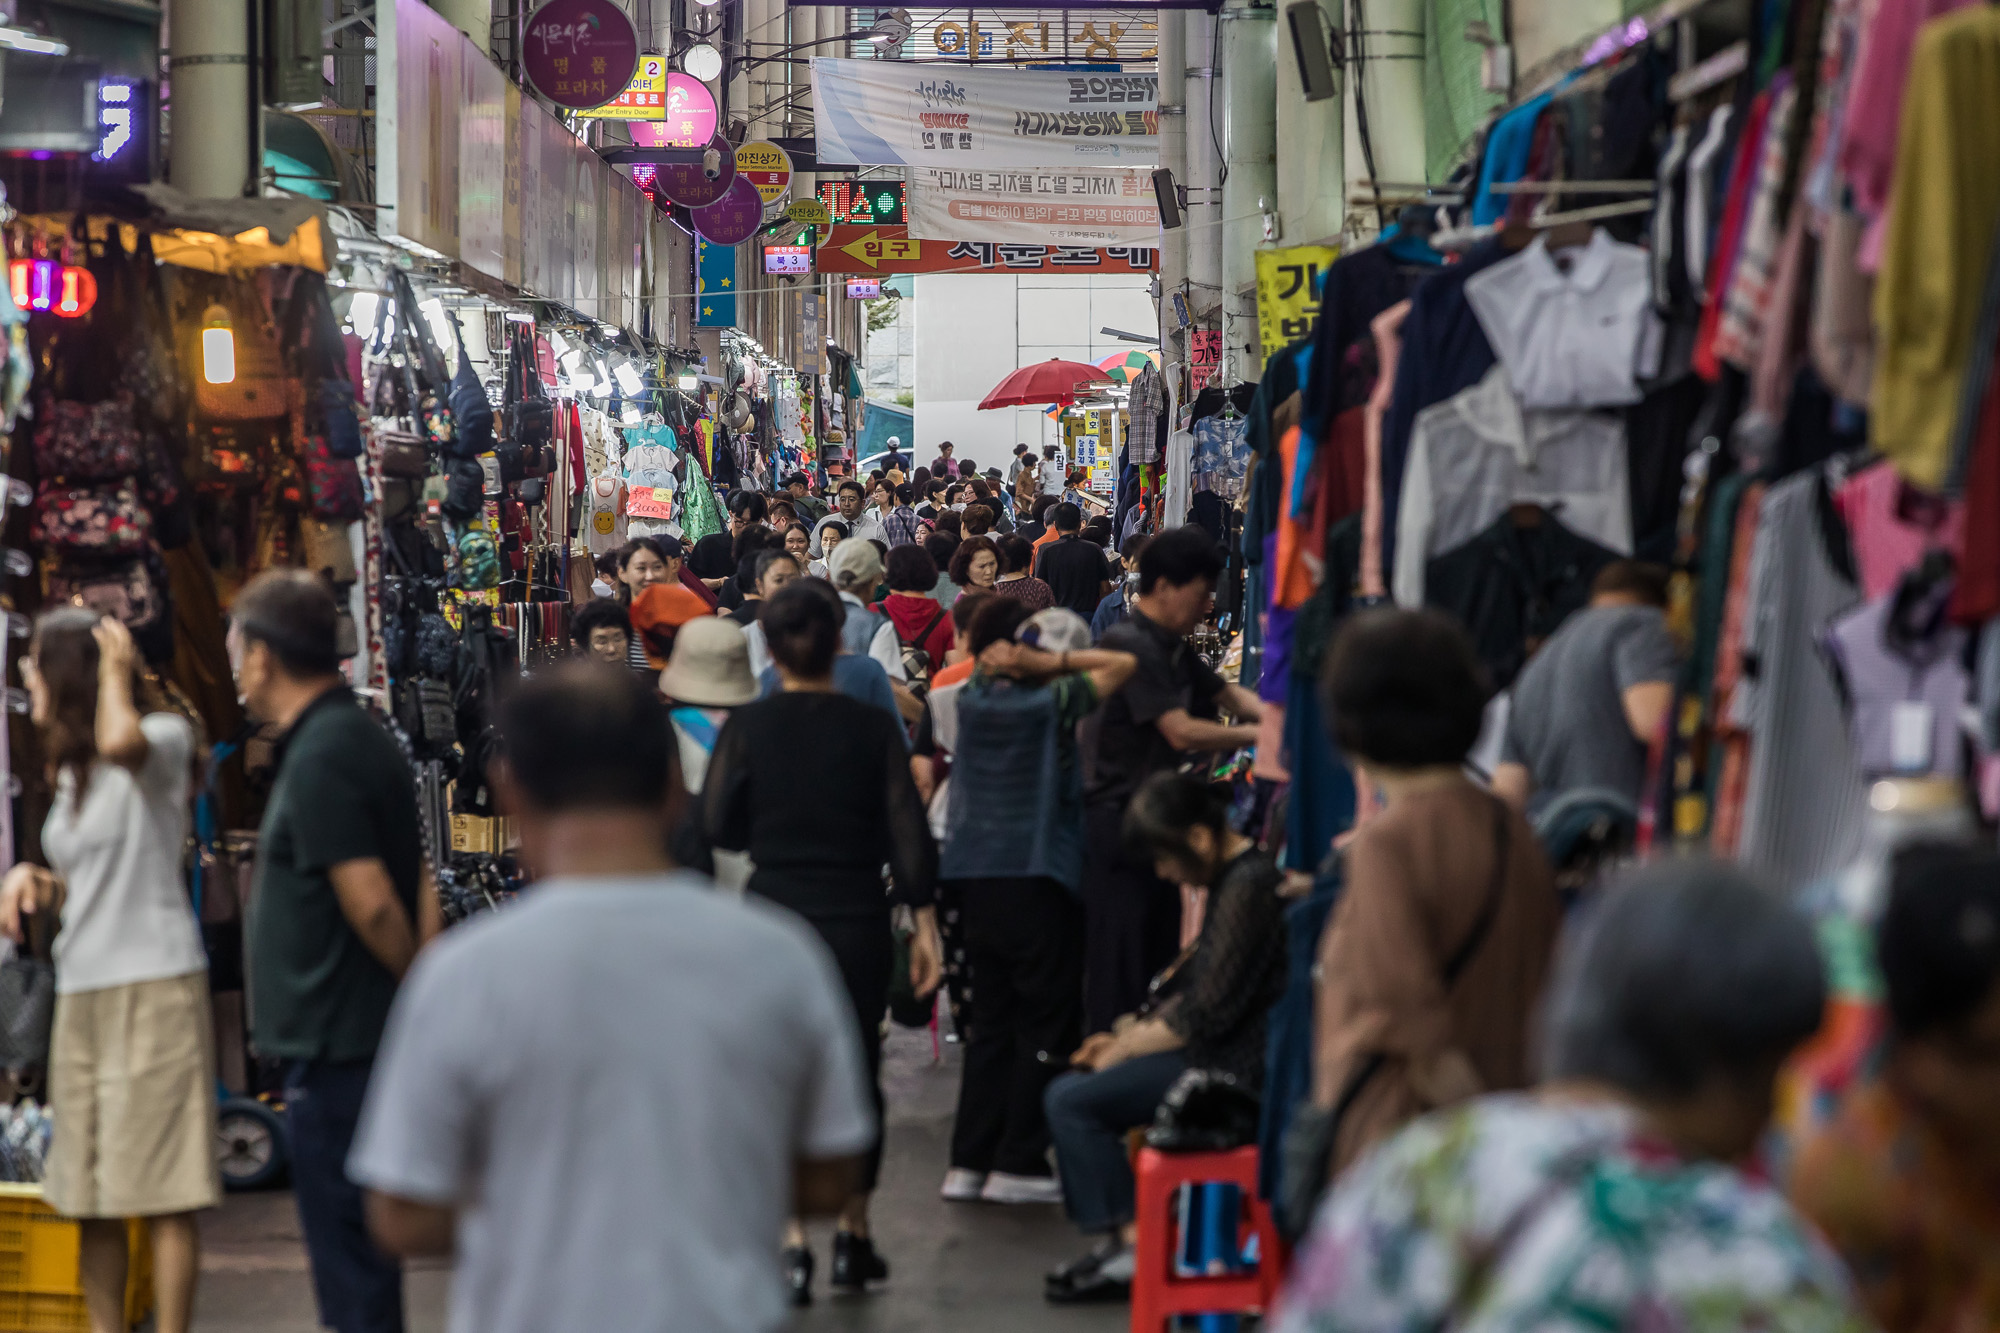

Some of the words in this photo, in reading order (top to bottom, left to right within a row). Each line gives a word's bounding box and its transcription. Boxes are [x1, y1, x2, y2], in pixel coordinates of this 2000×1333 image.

[648, 62, 658, 75] 2
[554, 79, 608, 96] 프라자
[737, 152, 782, 165] 아진상가
[789, 208, 824, 218] 아진상가
[863, 241, 911, 257] 입구
[791, 255, 798, 265] 3
